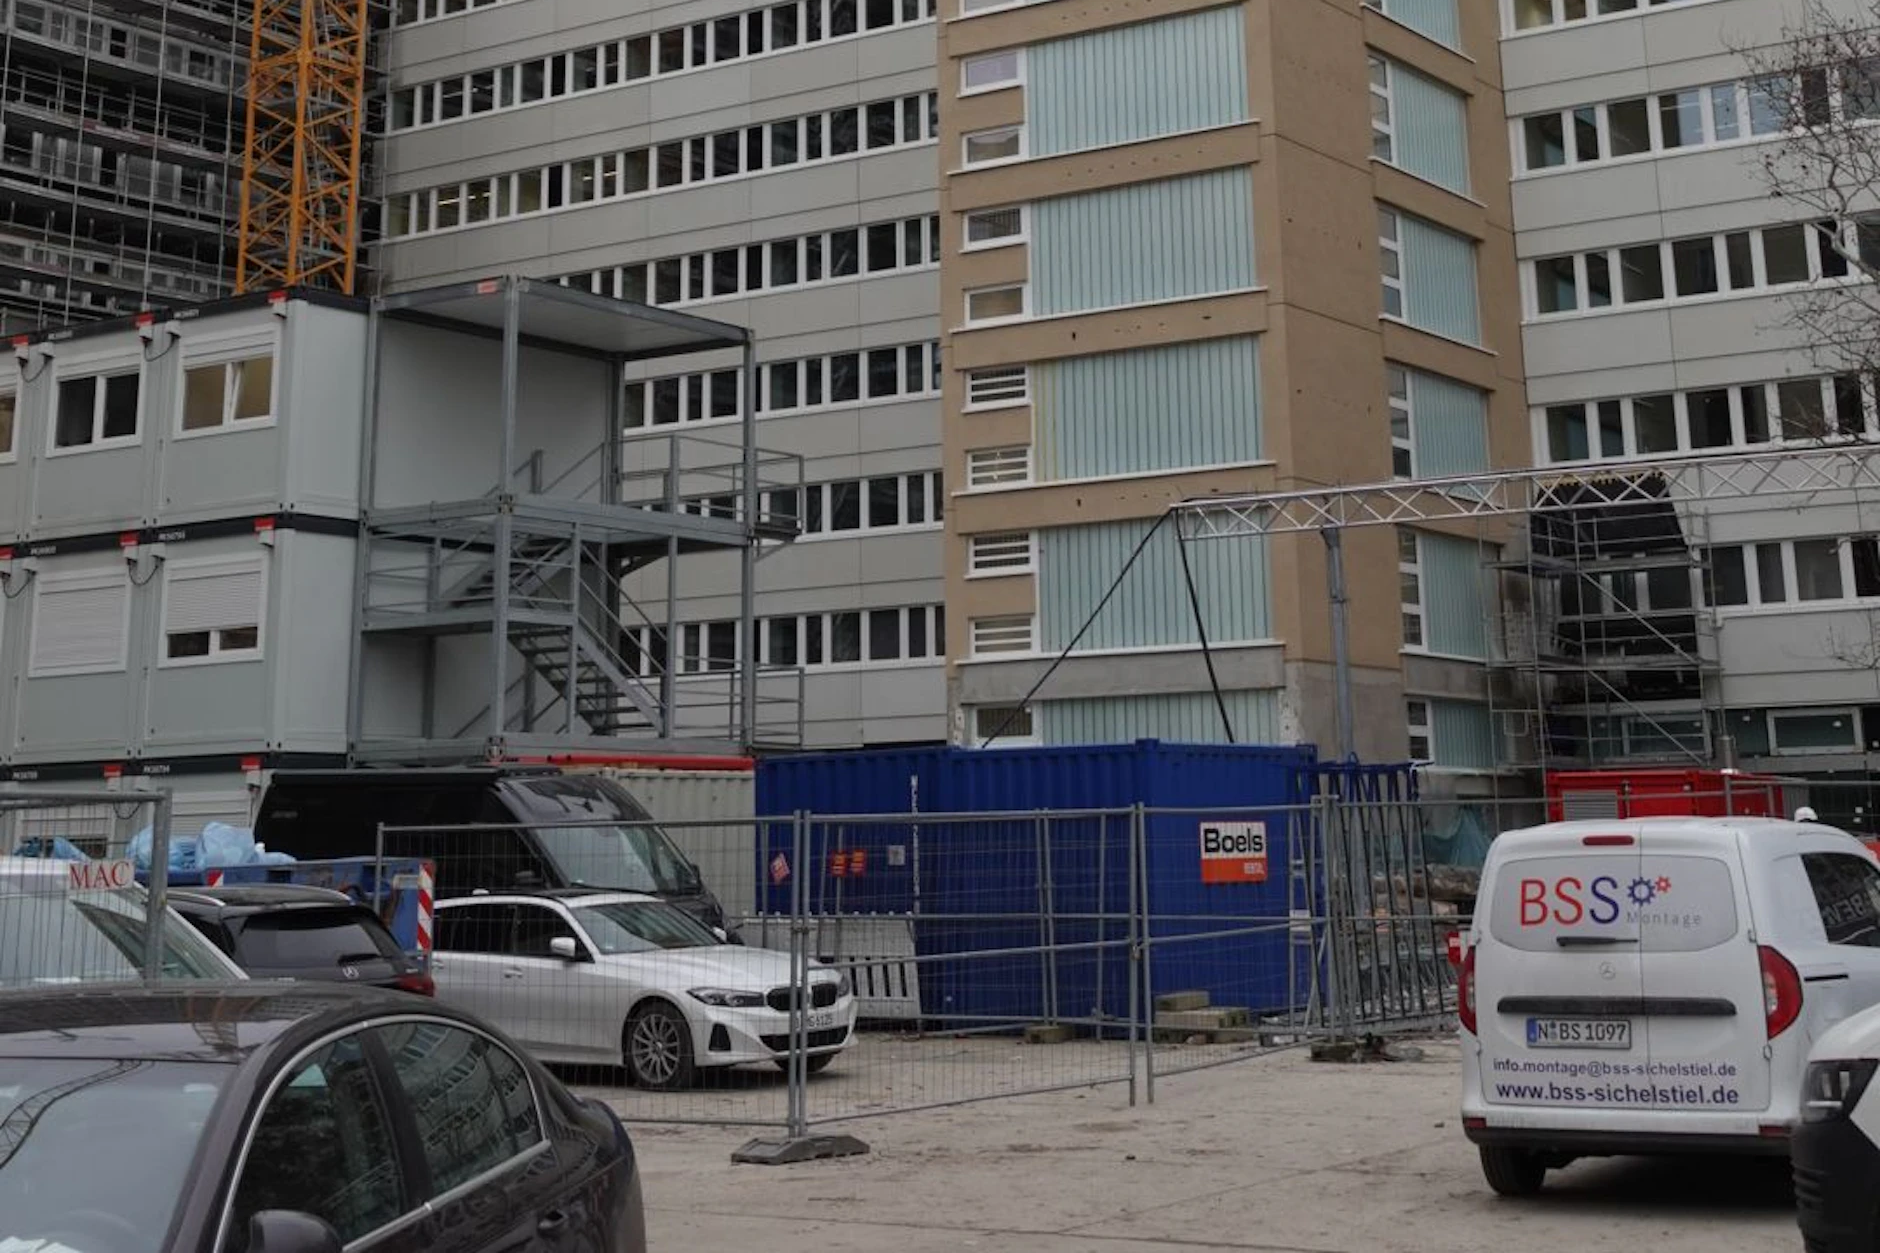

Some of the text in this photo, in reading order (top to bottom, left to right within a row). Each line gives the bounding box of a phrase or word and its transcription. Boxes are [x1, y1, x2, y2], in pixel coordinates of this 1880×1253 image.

[1204, 828, 1263, 853] Boels
[69, 860, 130, 890] MAC
[1520, 875, 1620, 926] BSS
[1626, 911, 1702, 928] Montage
[1538, 1023, 1627, 1042] N BS 1097
[1493, 1058, 1737, 1078] info.montage@bss-sichelstiel.de
[1496, 1082, 1740, 1105] www.bss-sichelstiel.de
